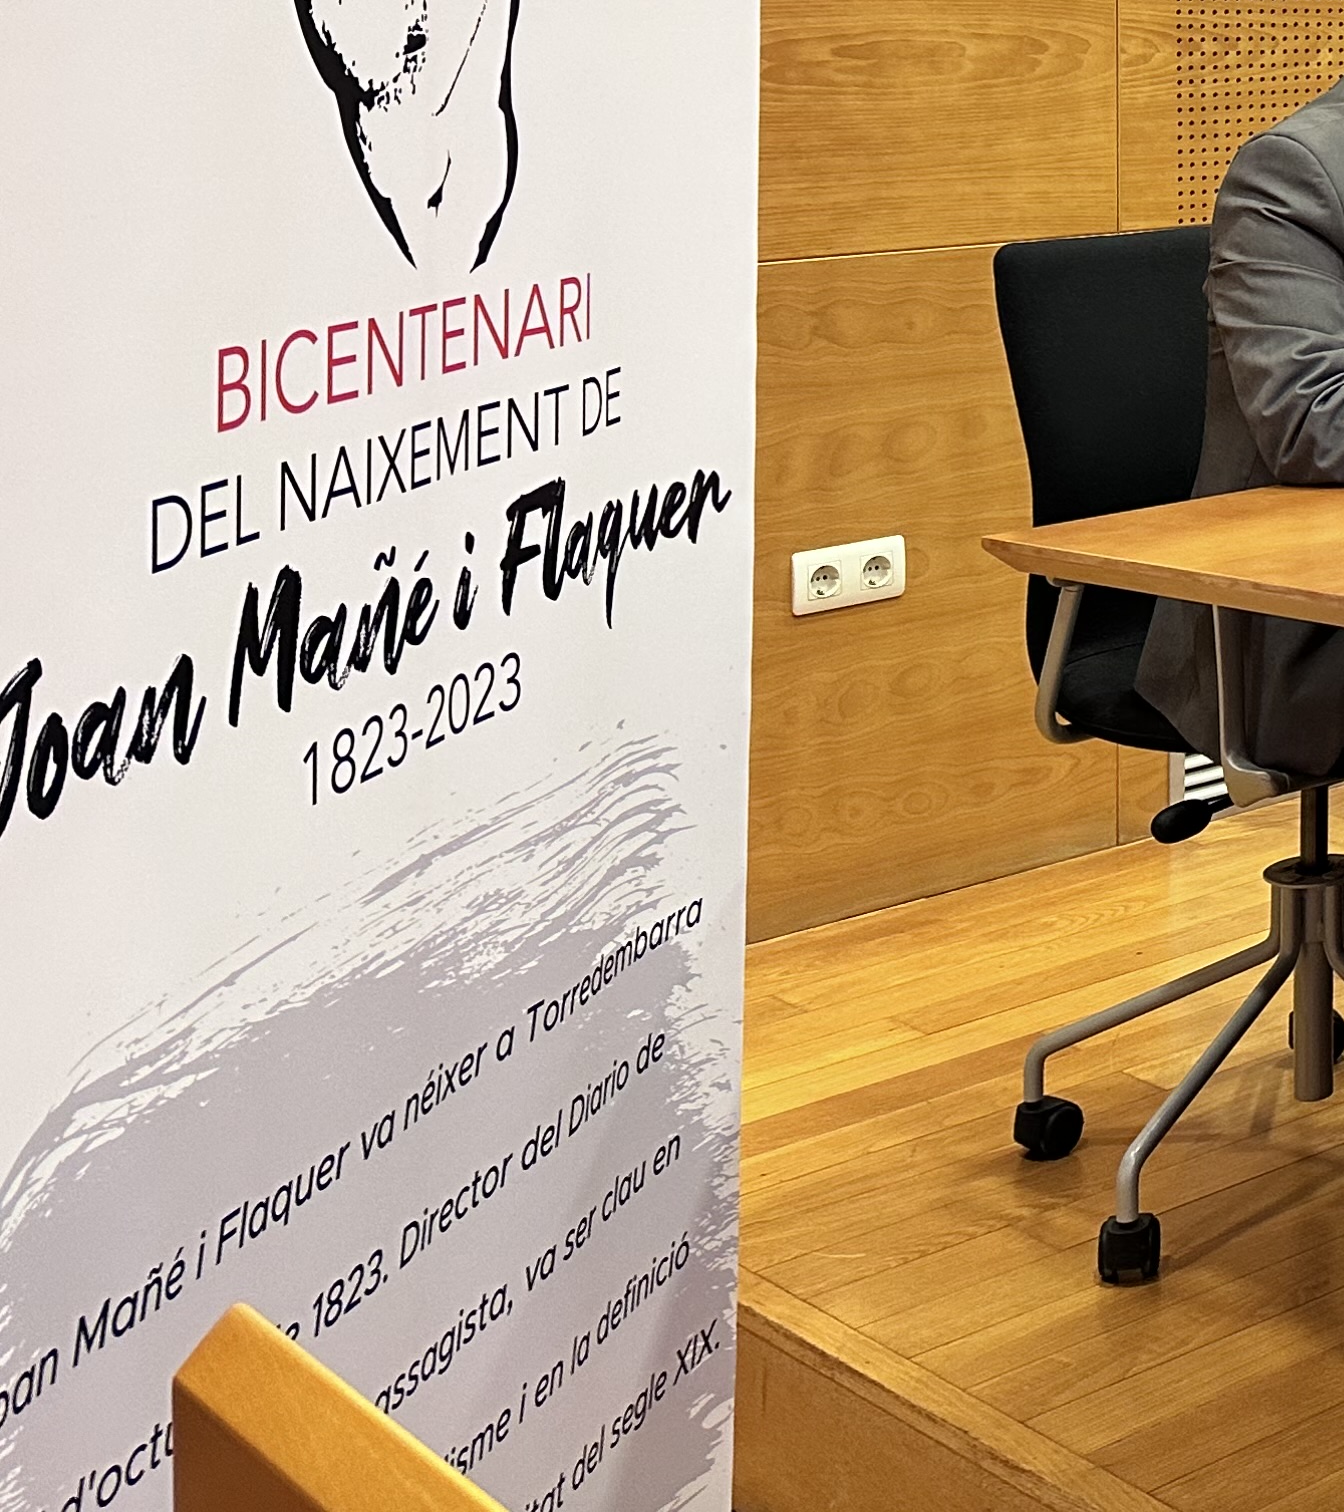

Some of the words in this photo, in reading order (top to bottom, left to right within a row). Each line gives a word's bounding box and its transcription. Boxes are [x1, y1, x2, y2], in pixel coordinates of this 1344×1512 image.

[217, 273, 591, 432] BICENTENARI
[151, 475, 260, 574] DEL
[279, 384, 570, 531] NAIXEMENT
[582, 367, 622, 437] DE
[0, 654, 206, 837] Joan
[229, 545, 439, 727] Mañé
[453, 532, 480, 631] i
[501, 468, 732, 629] Flaquer
[302, 652, 522, 806] 1823-2023
[72, 1246, 187, 1368] Mañé
[195, 1229, 207, 1280] i
[215, 1140, 350, 1266] Flaquer
[360, 1110, 396, 1161] va
[402, 1040, 488, 1132] néixer
[495, 1023, 516, 1062] a
[527, 896, 704, 1043] Torredembarra
[312, 1248, 389, 1338] 1823.
[399, 1151, 514, 1270] Director
[521, 1108, 563, 1171] del
[568, 1059, 630, 1138] Diario
[636, 1030, 666, 1076] de
[525, 1244, 557, 1292] va
[563, 1210, 597, 1261] ser
[600, 1161, 647, 1224] clau
[652, 1133, 680, 1176] en
[519, 1381, 528, 1425] i
[534, 1357, 564, 1408] en
[570, 1324, 590, 1377] la
[596, 1230, 690, 1346] definició
[571, 1425, 606, 1491] del
[610, 1368, 667, 1450] segle
[673, 1318, 722, 1386] XIX.
